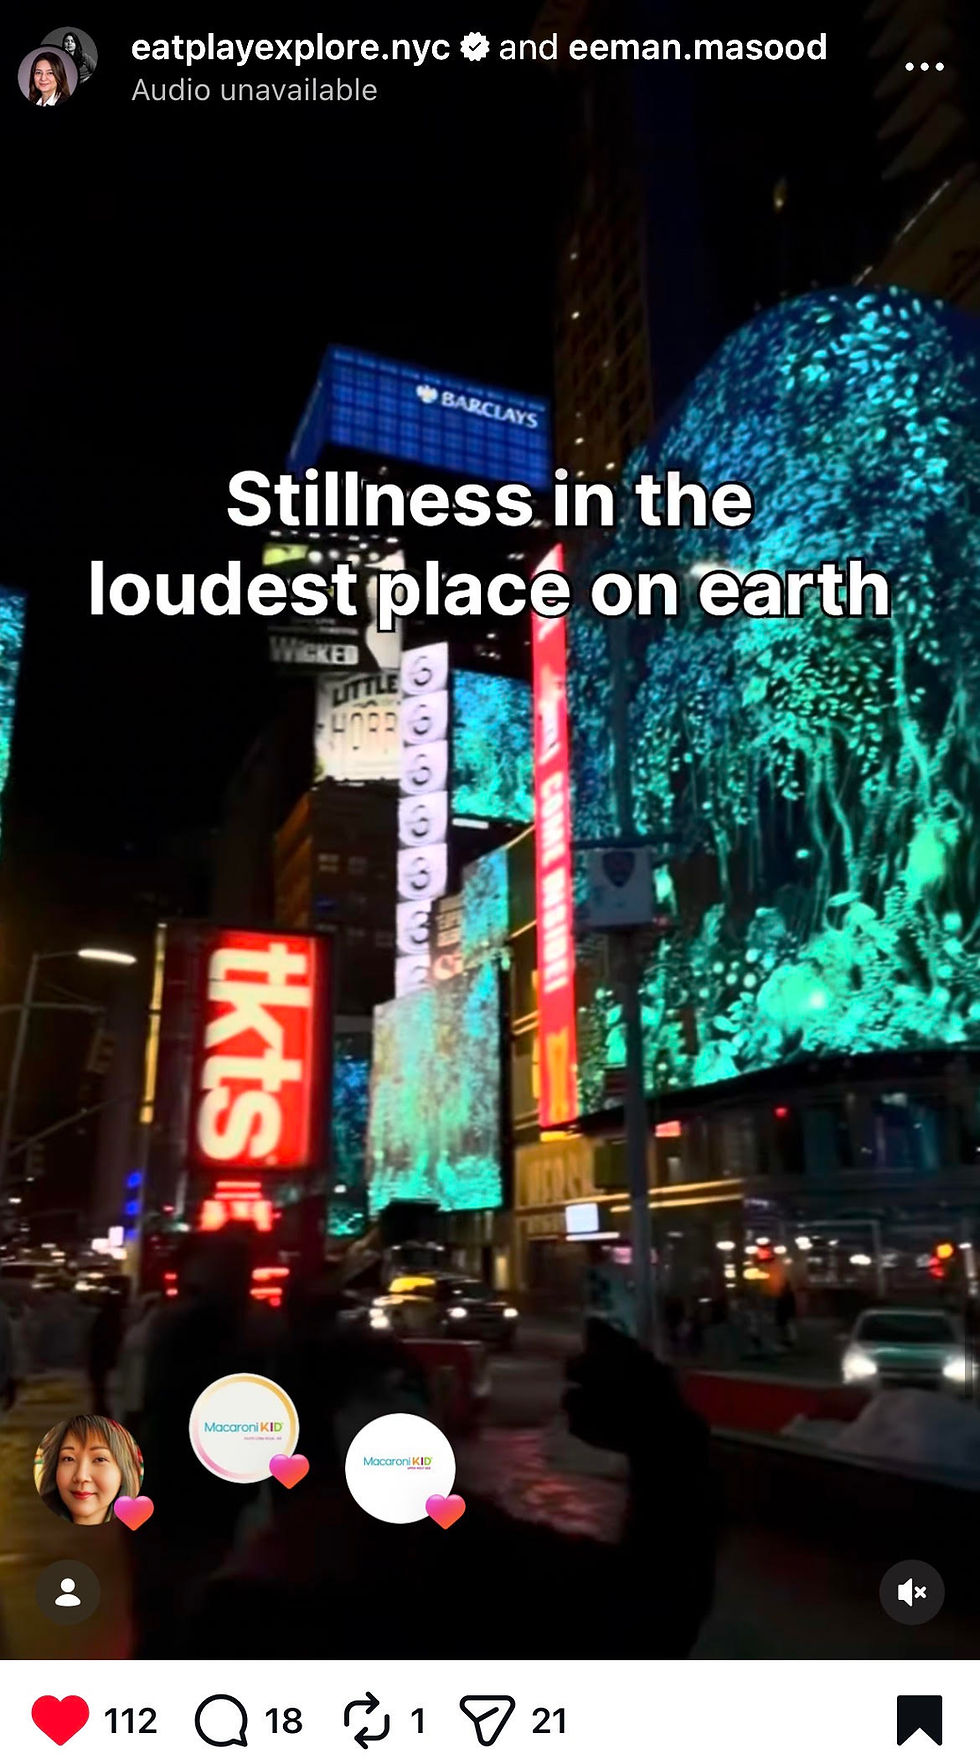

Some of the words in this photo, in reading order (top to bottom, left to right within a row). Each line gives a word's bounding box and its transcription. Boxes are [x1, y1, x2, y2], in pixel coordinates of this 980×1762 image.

[441, 391, 538, 428] BARCLAYS
[332, 674, 398, 706] LITTLE
[540, 771, 565, 869] COME
[196, 942, 310, 1161] tkts
